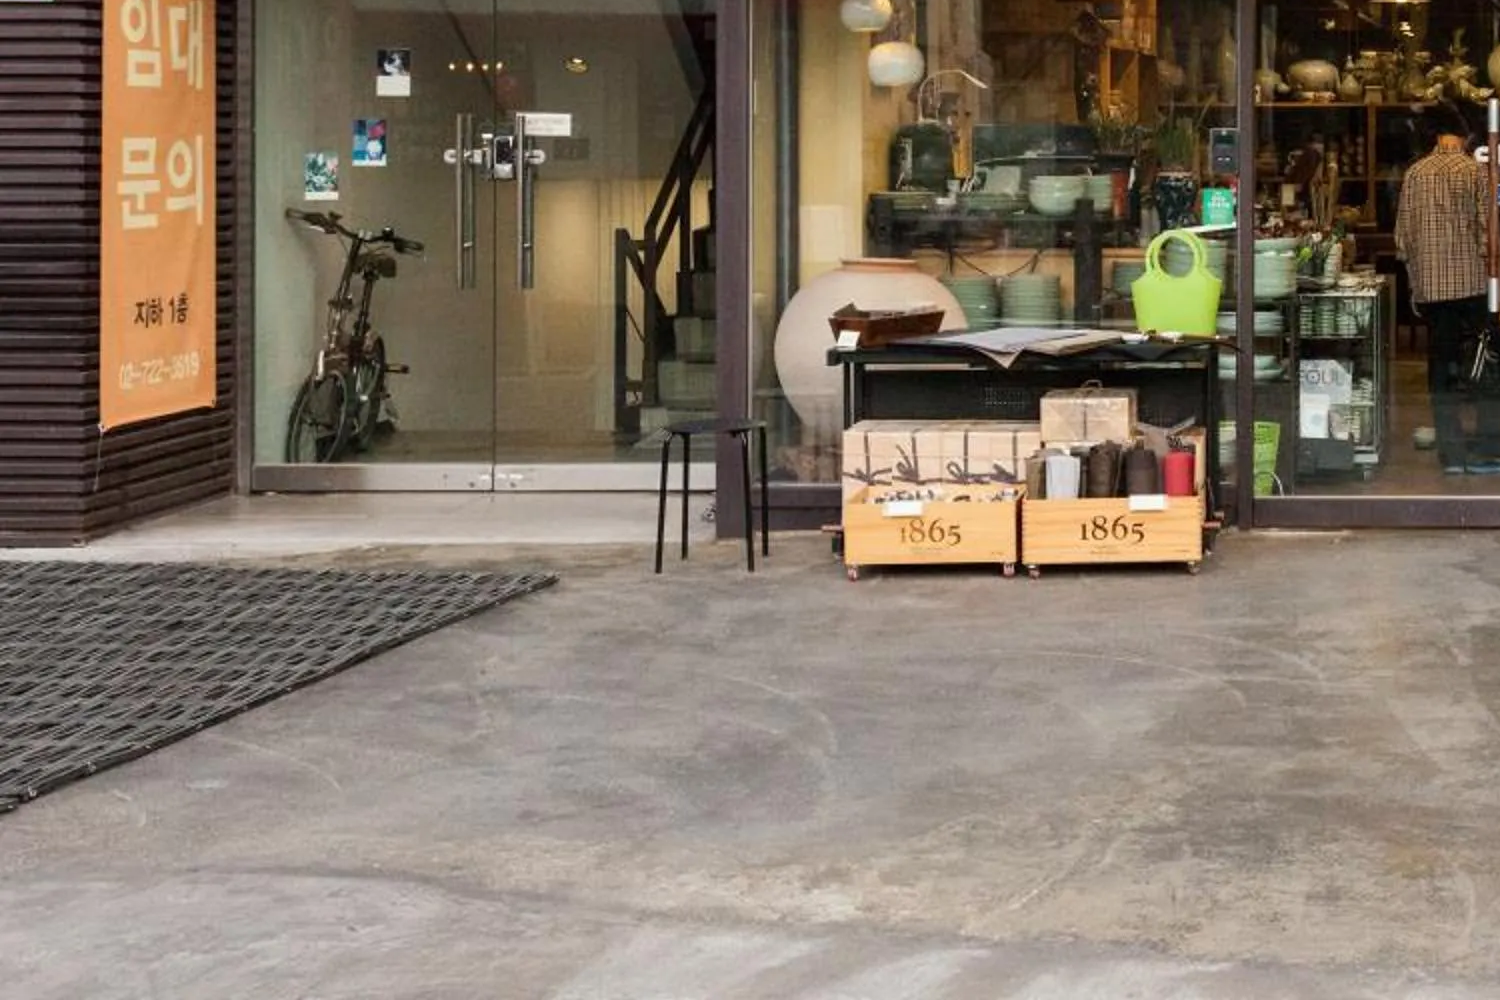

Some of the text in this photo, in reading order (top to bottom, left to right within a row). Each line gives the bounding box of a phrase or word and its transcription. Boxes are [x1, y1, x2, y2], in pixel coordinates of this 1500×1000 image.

[116, 134, 204, 229] 문의
[134, 292, 189, 328] 지하 1층
[901, 517, 962, 546] 1865
[1080, 515, 1146, 544] 1865
